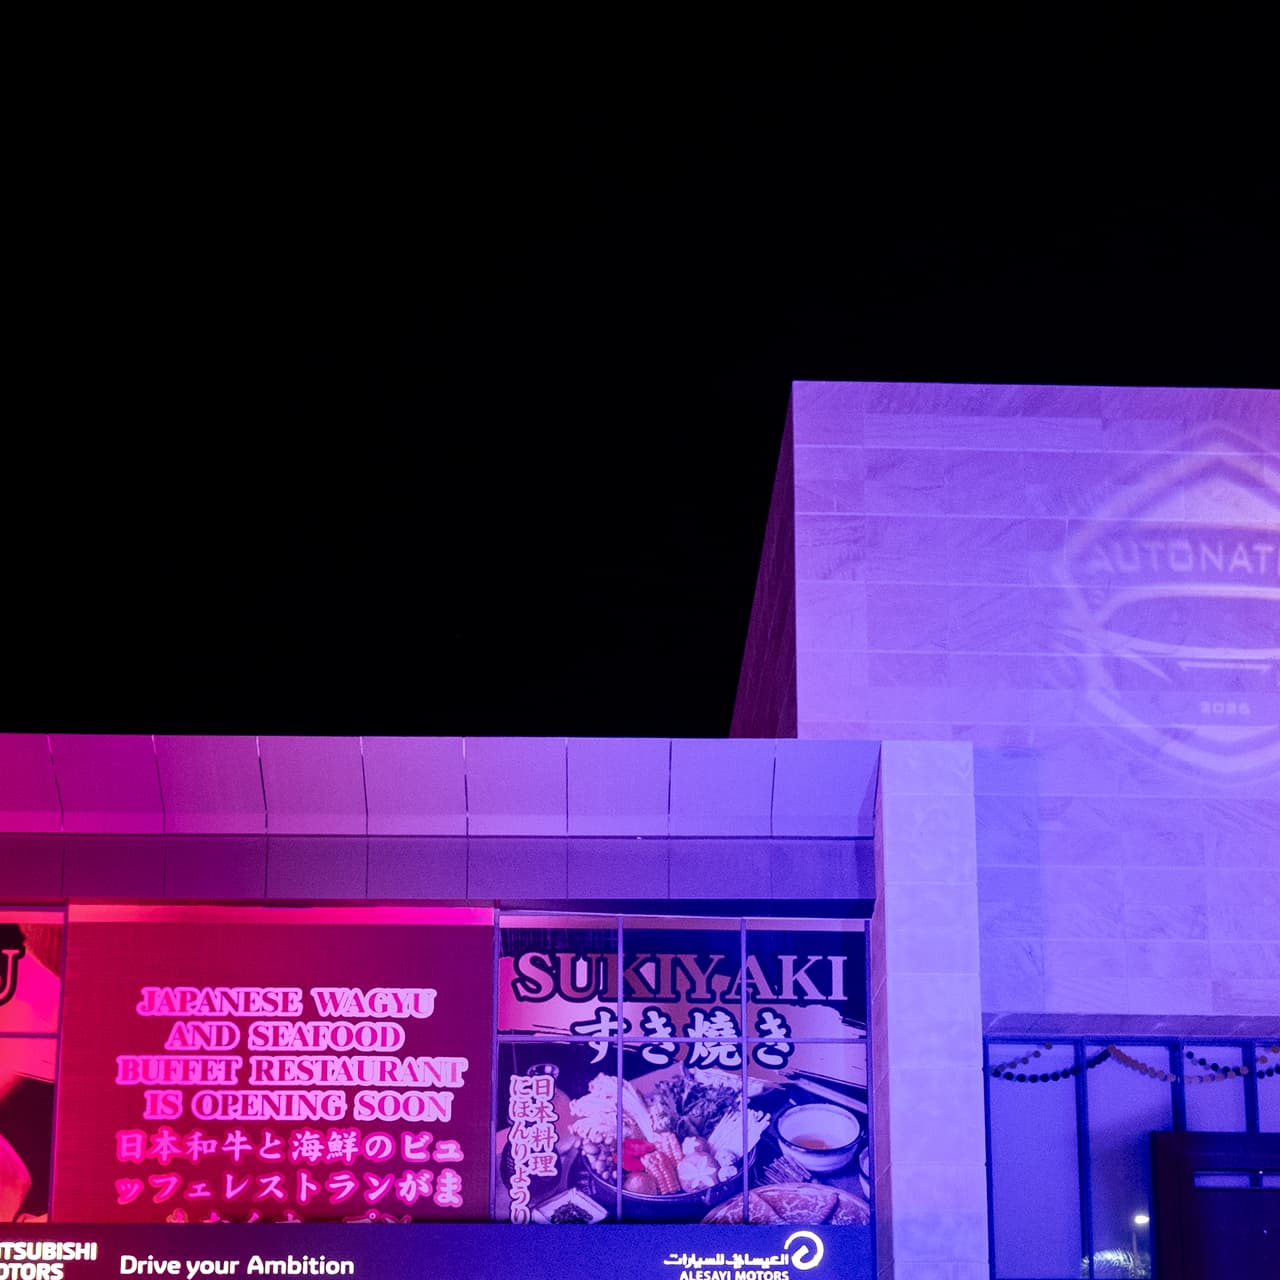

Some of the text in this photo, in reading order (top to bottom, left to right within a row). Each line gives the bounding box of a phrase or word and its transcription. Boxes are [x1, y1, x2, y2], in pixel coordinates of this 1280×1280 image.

[514, 952, 849, 1001] SUKIYAKI
[137, 987, 437, 1017] JAPANESE WAGYU
[165, 1021, 405, 1051] AND SEAFOOD
[116, 1056, 468, 1087] BUFFET RESTAURANT
[144, 1090, 454, 1121] IS OPENING SOON
[529, 1075, 559, 1176] 日本料理
[118, 1127, 464, 1164] 日本和牛と海鮮のビュ
[116, 1169, 464, 1207] ッフェレストランがま
[120, 1255, 355, 1280] Drive your Ambition
